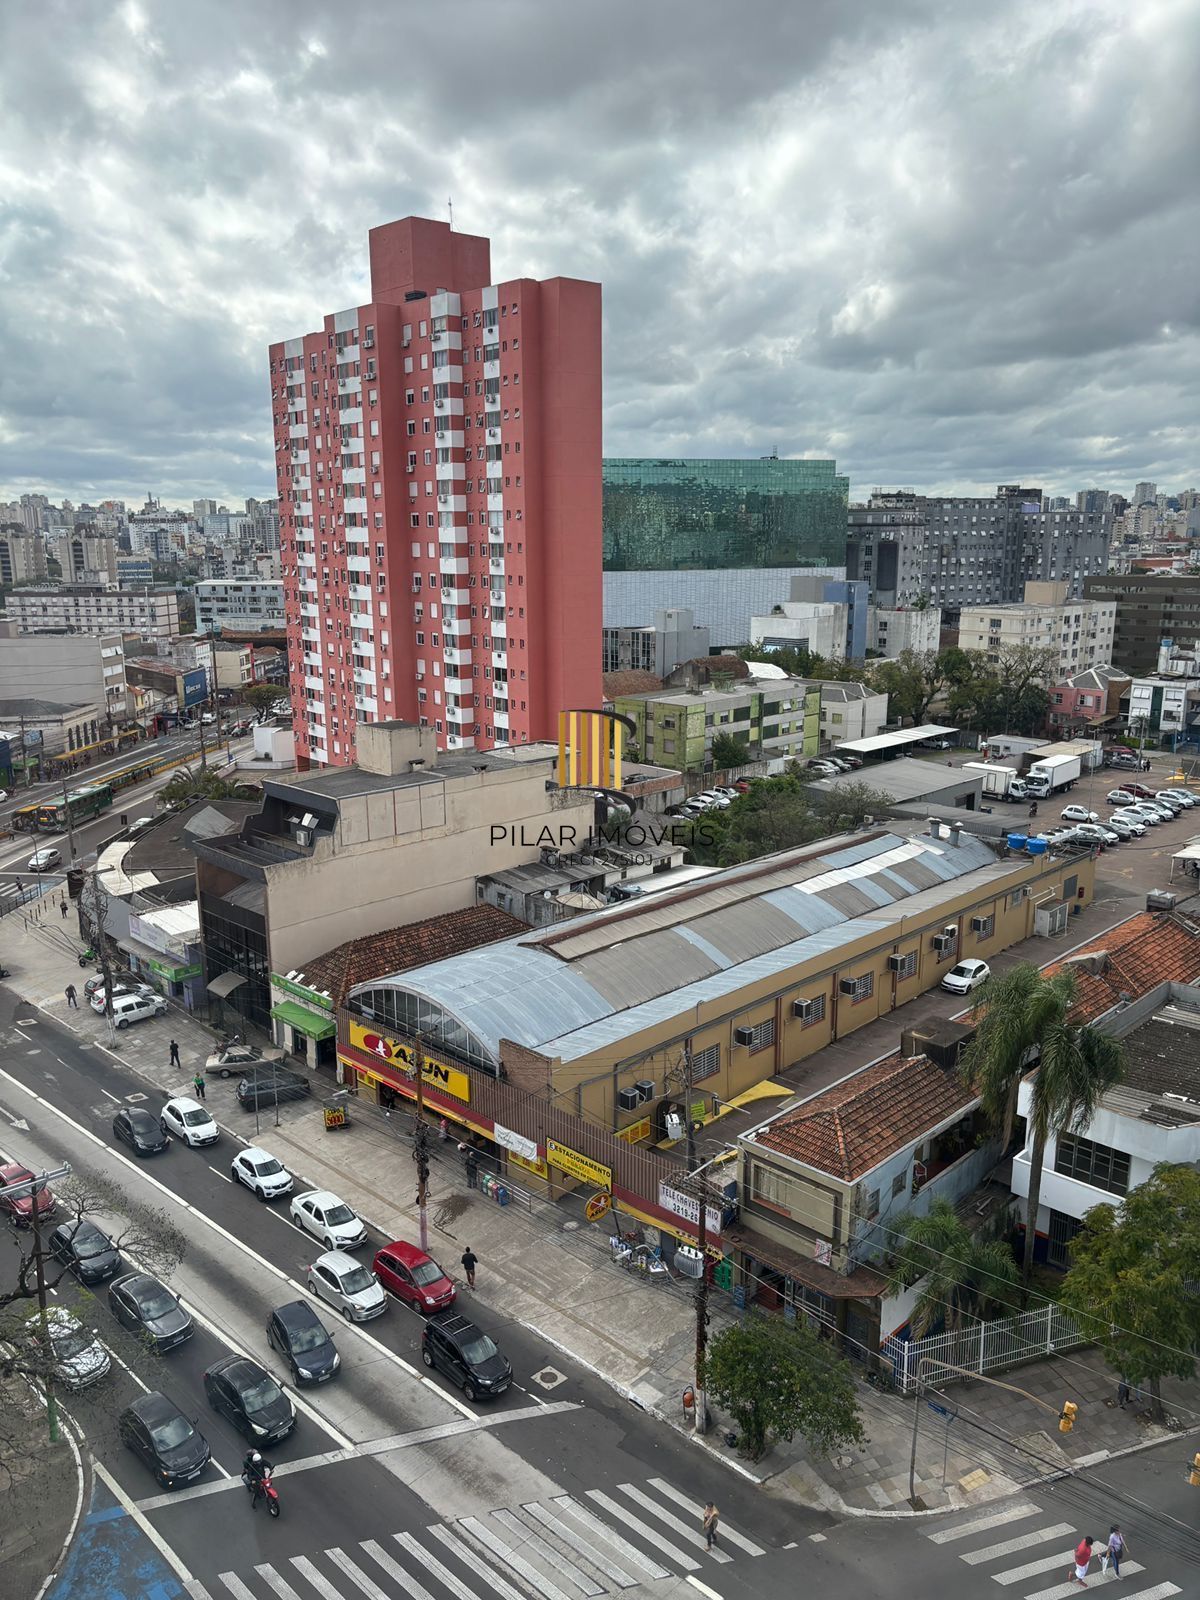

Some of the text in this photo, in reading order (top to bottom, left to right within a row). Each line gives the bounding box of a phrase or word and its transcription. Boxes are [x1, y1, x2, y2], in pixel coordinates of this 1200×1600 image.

[394, 1048, 450, 1083] AUN
[555, 1145, 611, 1178] ESTACIONAMENTO
[662, 1186, 676, 1200] TELE
